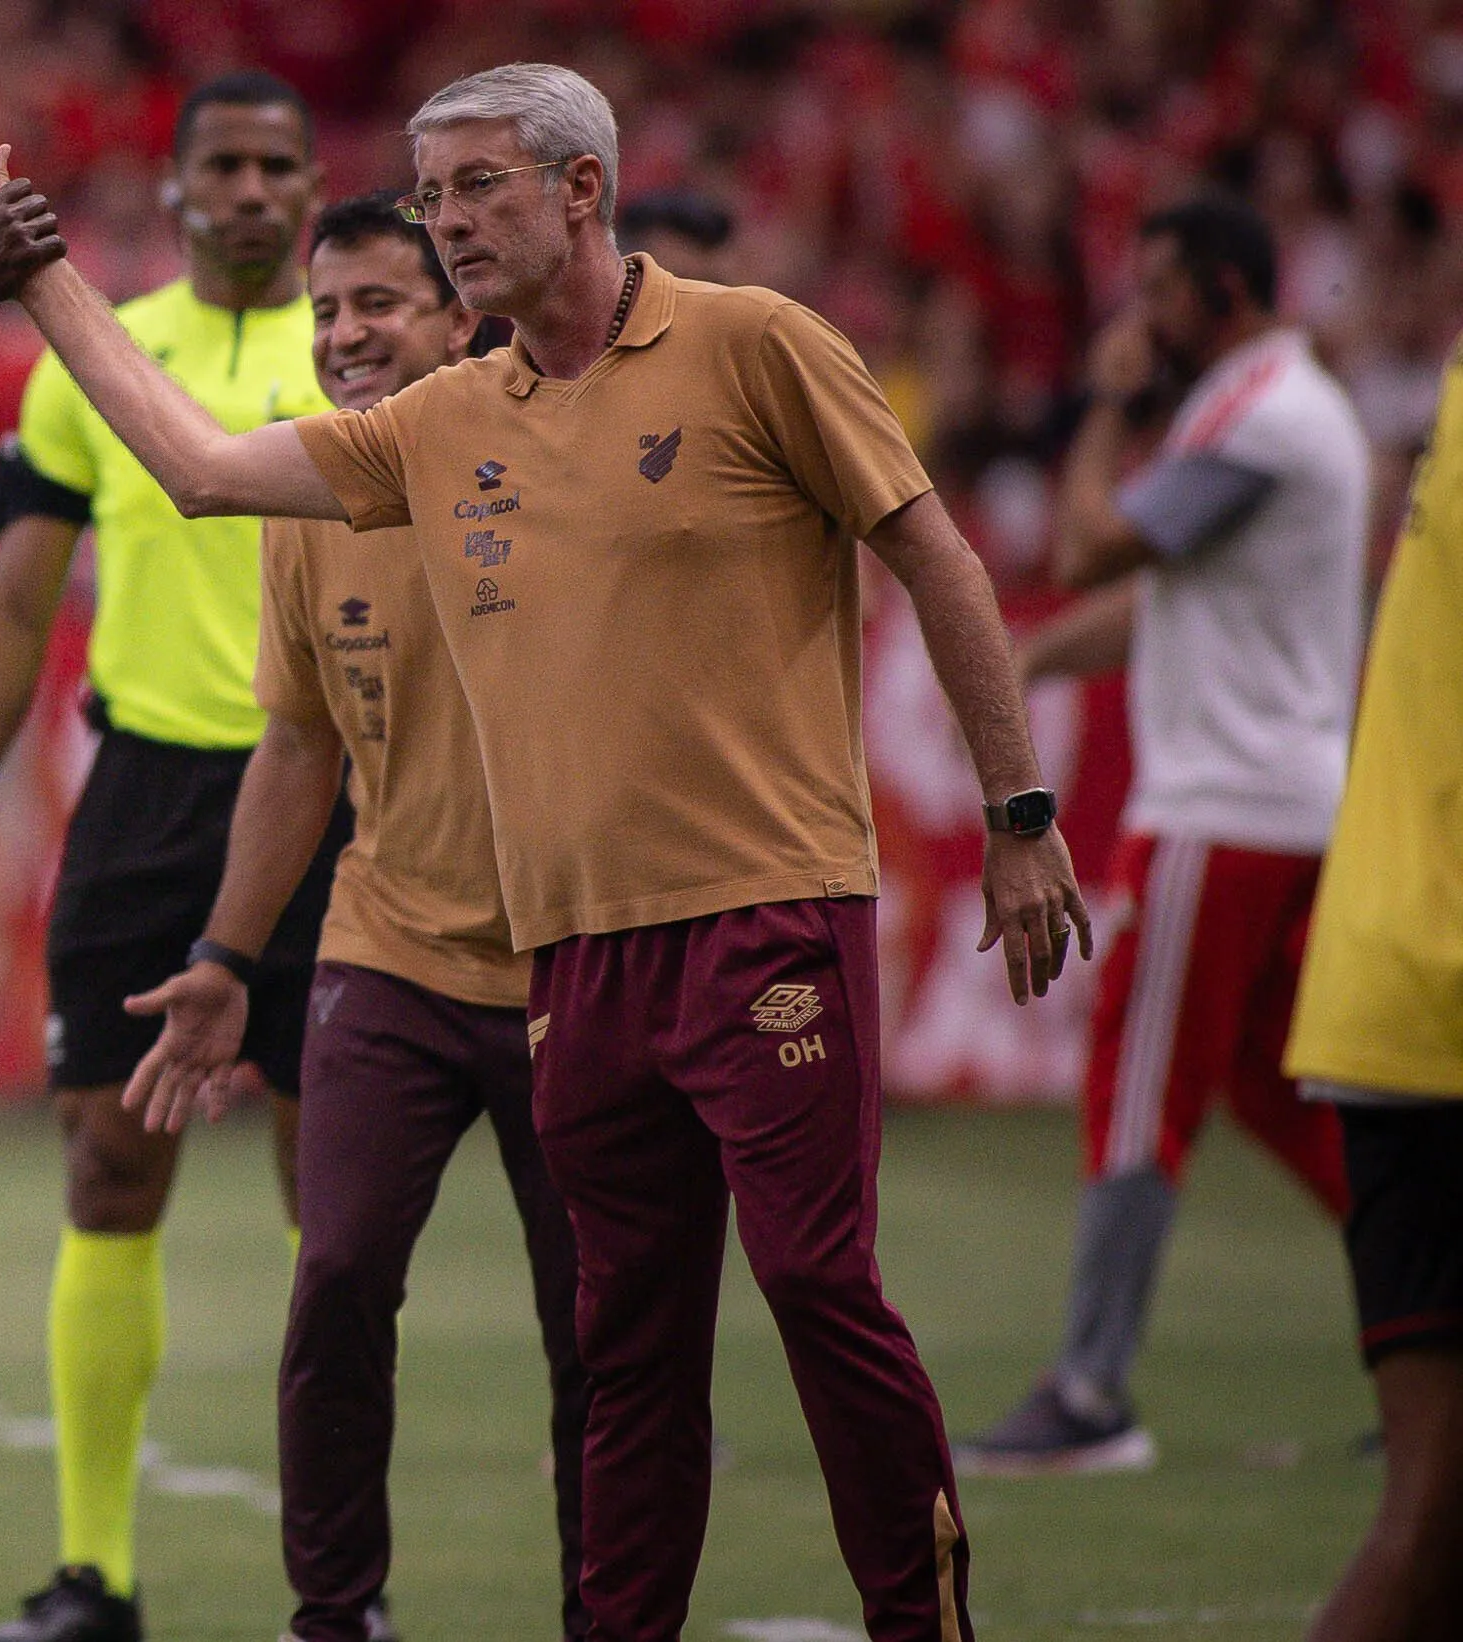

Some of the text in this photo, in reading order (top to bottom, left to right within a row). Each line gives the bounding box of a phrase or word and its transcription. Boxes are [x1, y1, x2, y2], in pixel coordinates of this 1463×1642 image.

[453, 488, 521, 522] Copacol
[470, 599, 515, 617] ADEMICON
[760, 998, 814, 1019] PRO
[766, 1006, 819, 1029] TRAINING
[778, 1034, 826, 1068] OH
